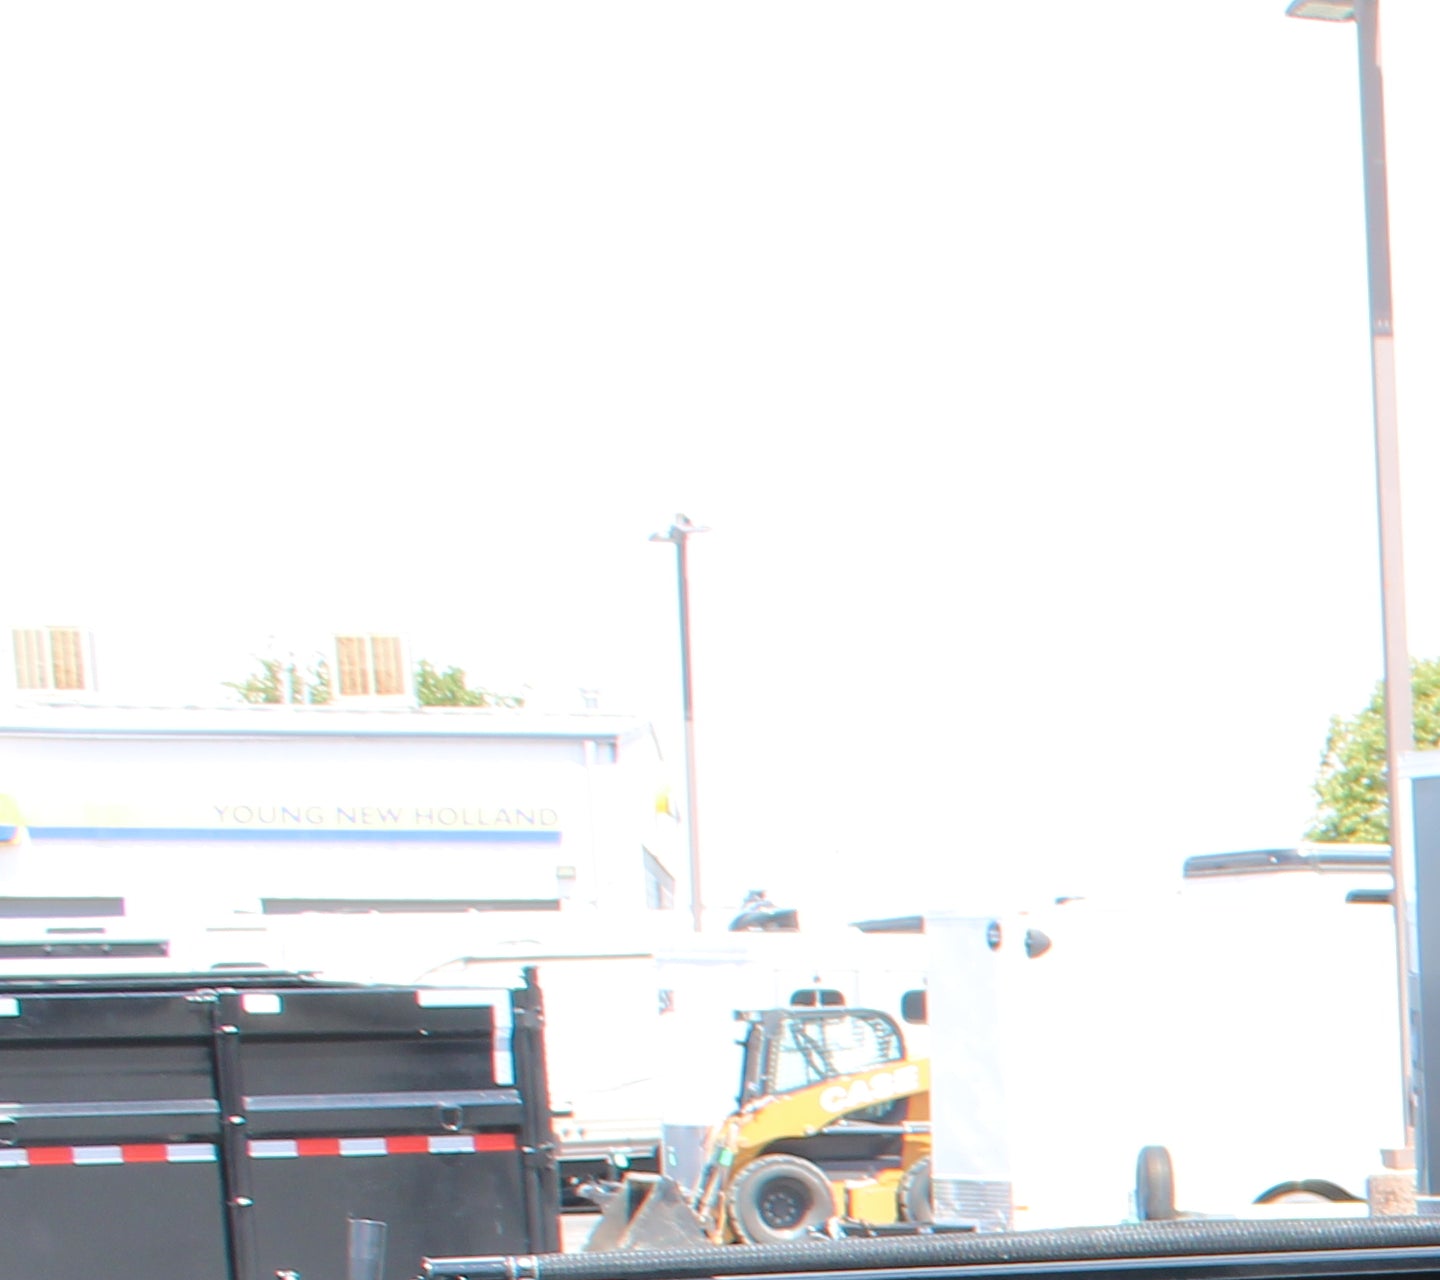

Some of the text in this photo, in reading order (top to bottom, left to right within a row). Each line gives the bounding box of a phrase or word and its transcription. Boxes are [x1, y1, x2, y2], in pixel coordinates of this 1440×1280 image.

[213, 804, 560, 828] YOUNG NEW HOLLAND
[819, 1064, 920, 1114] CASE
